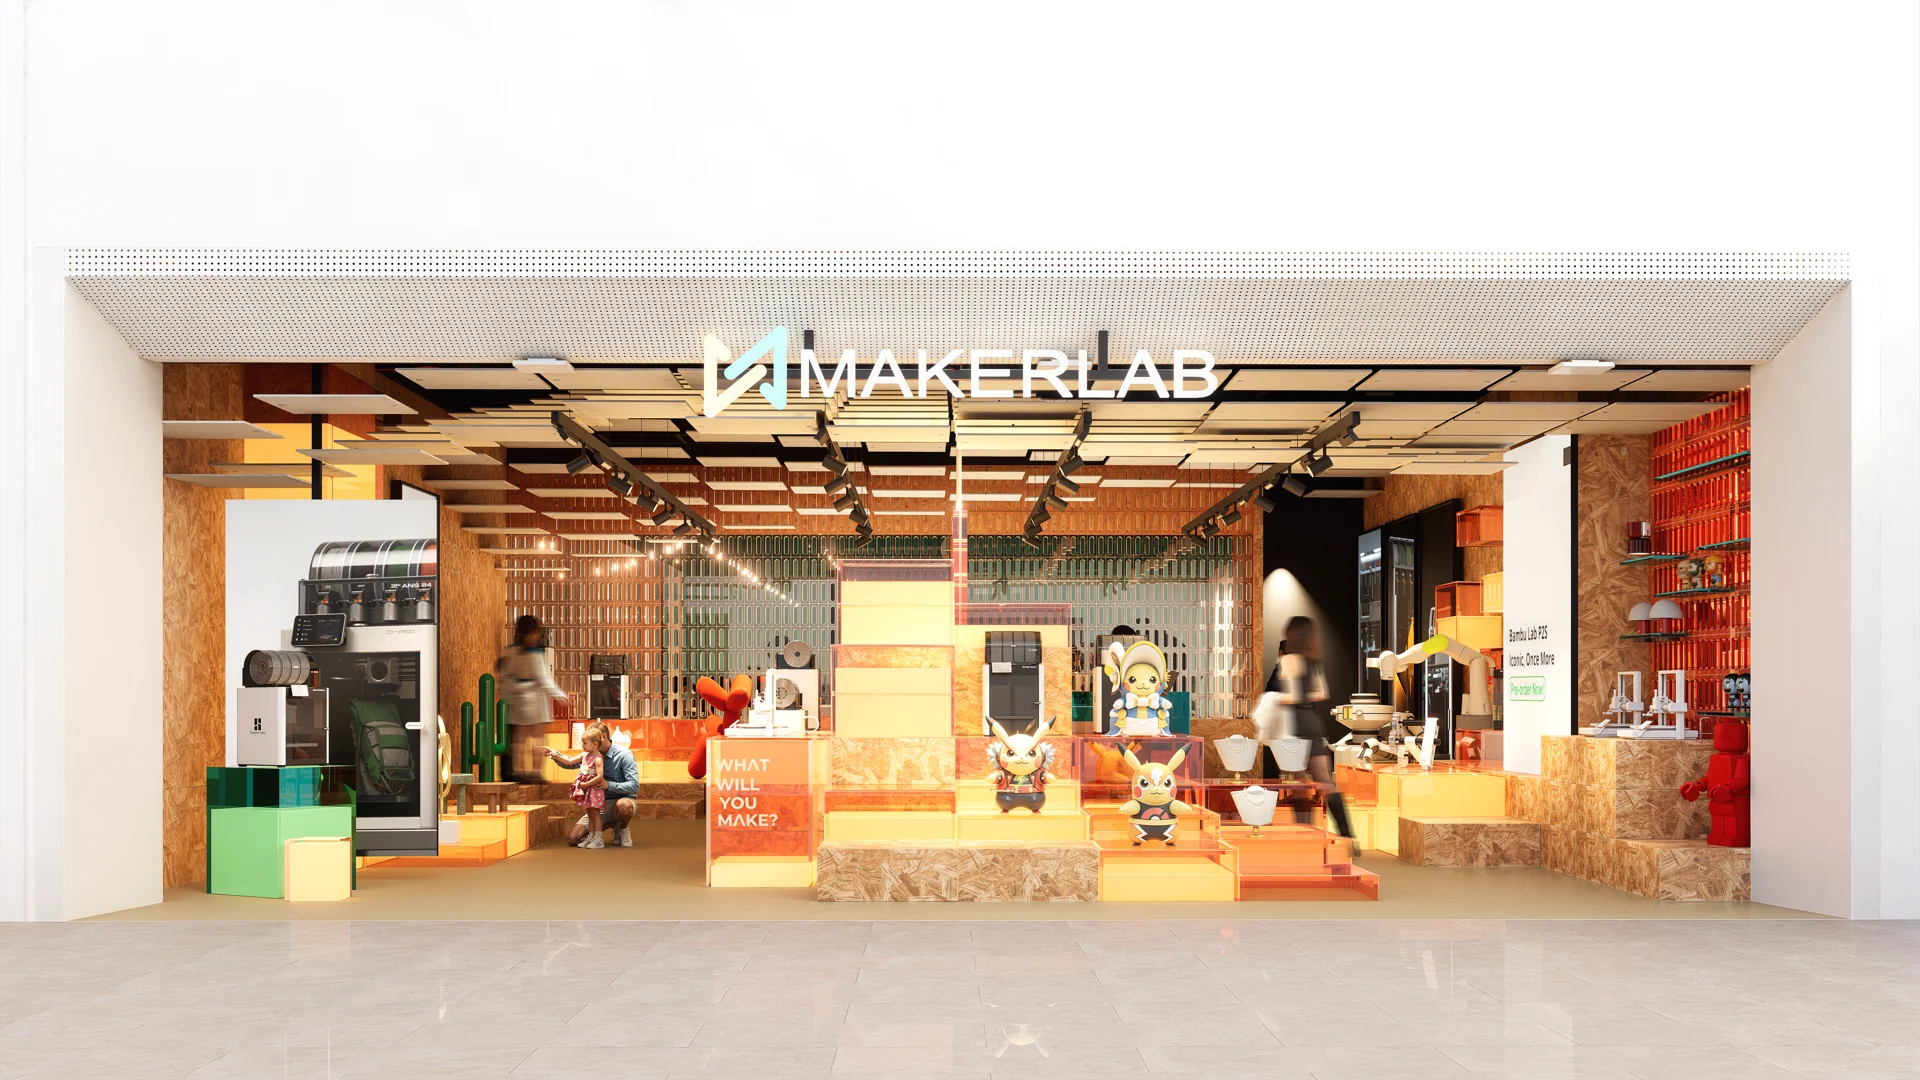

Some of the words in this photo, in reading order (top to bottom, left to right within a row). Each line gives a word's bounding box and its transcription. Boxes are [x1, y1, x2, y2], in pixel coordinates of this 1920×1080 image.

[800, 348, 1218, 399] MAKERLAB
[1509, 627, 1527, 642] Bambu
[1527, 626, 1538, 641] Lab
[1538, 625, 1548, 640] P2S
[1509, 653, 1526, 668] Iconic,
[1526, 652, 1540, 666] Once
[1540, 651, 1555, 666] More
[1511, 683, 1532, 696] Pre-order
[1532, 683, 1545, 695] Now!
[714, 758, 770, 772] WHAT
[715, 778, 760, 791] WILL
[719, 796, 757, 810] YOU
[717, 813, 779, 827] MAKE?
